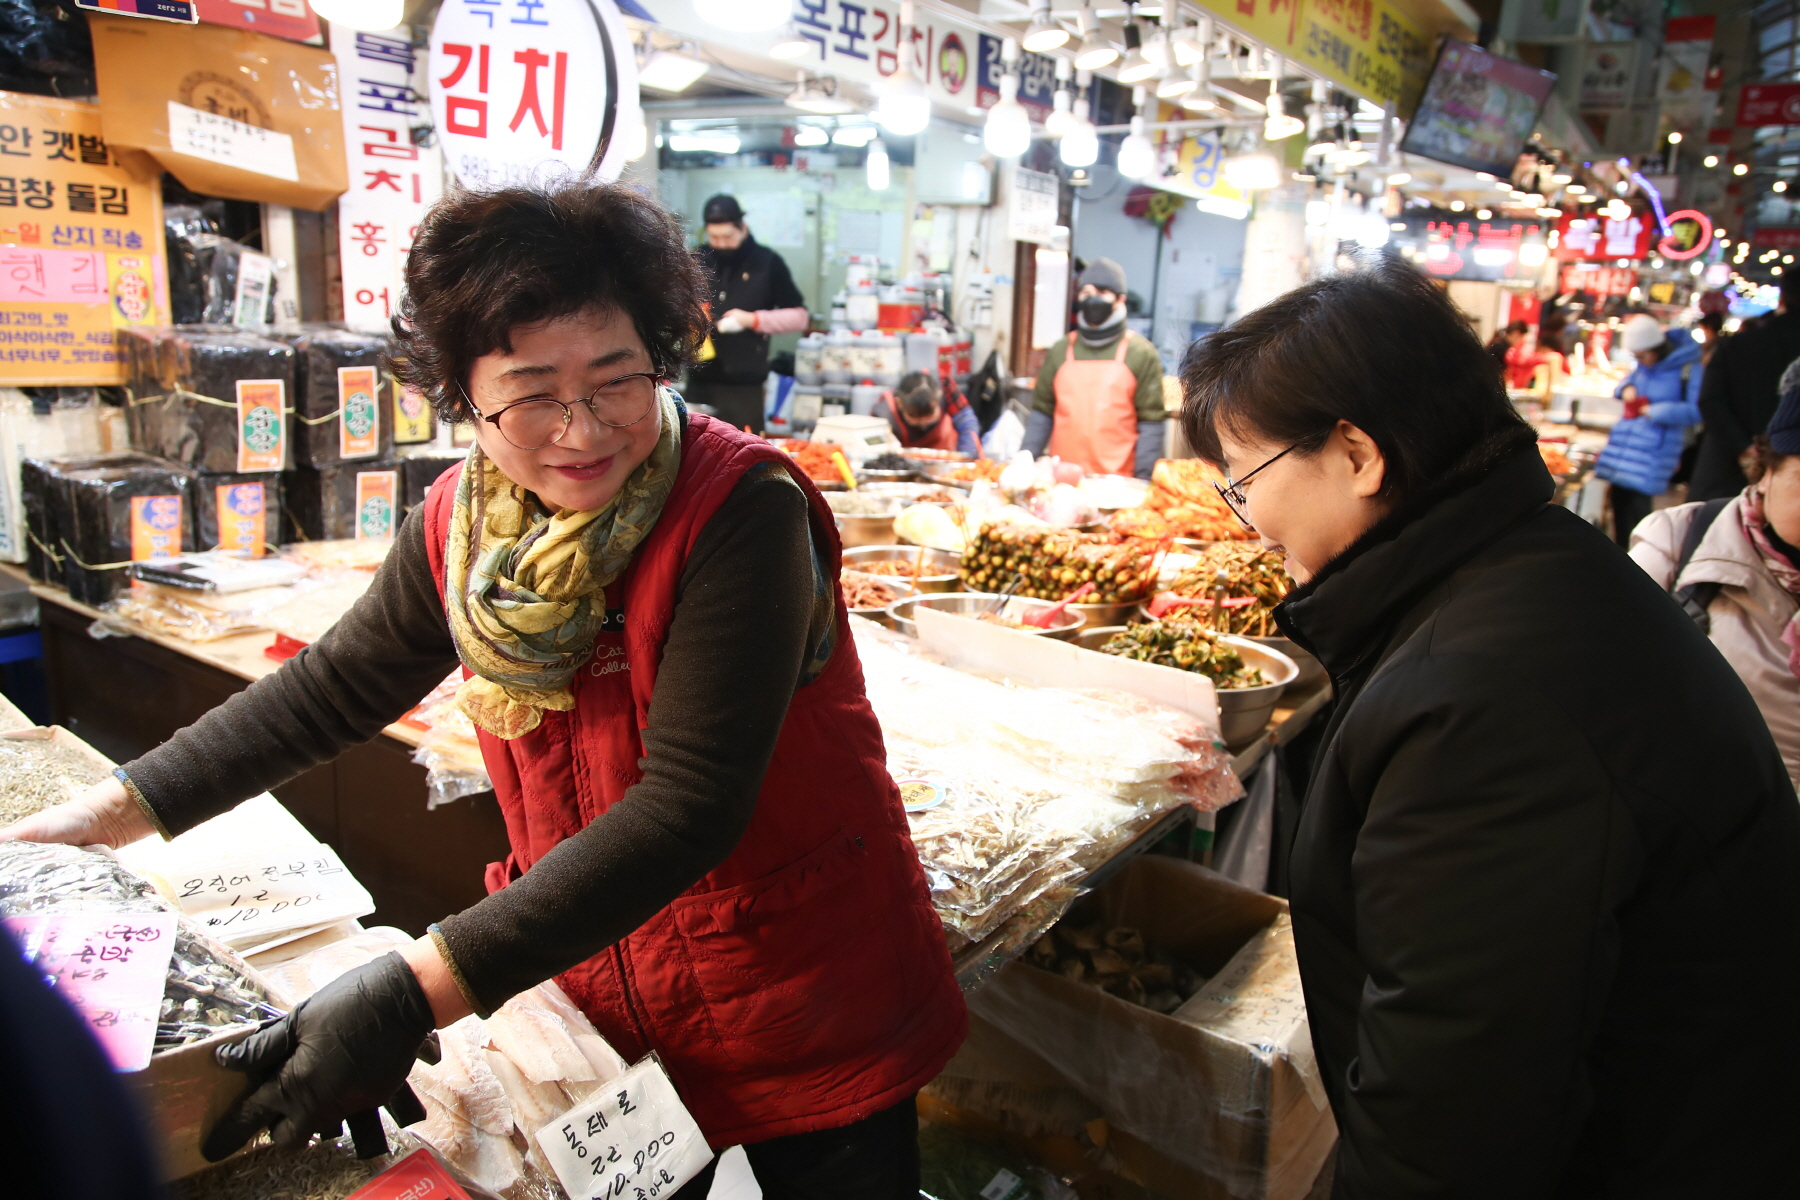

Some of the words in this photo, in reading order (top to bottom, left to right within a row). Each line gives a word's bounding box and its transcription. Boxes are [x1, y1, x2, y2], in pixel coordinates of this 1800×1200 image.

[438, 41, 569, 151] 김치
[41, 128, 120, 167] 갯벌
[66, 182, 129, 216] 돌김
[51, 224, 96, 247] 산지
[101, 228, 144, 250] 직송
[596, 644, 626, 661] Cat
[179, 874, 252, 898] 오징어
